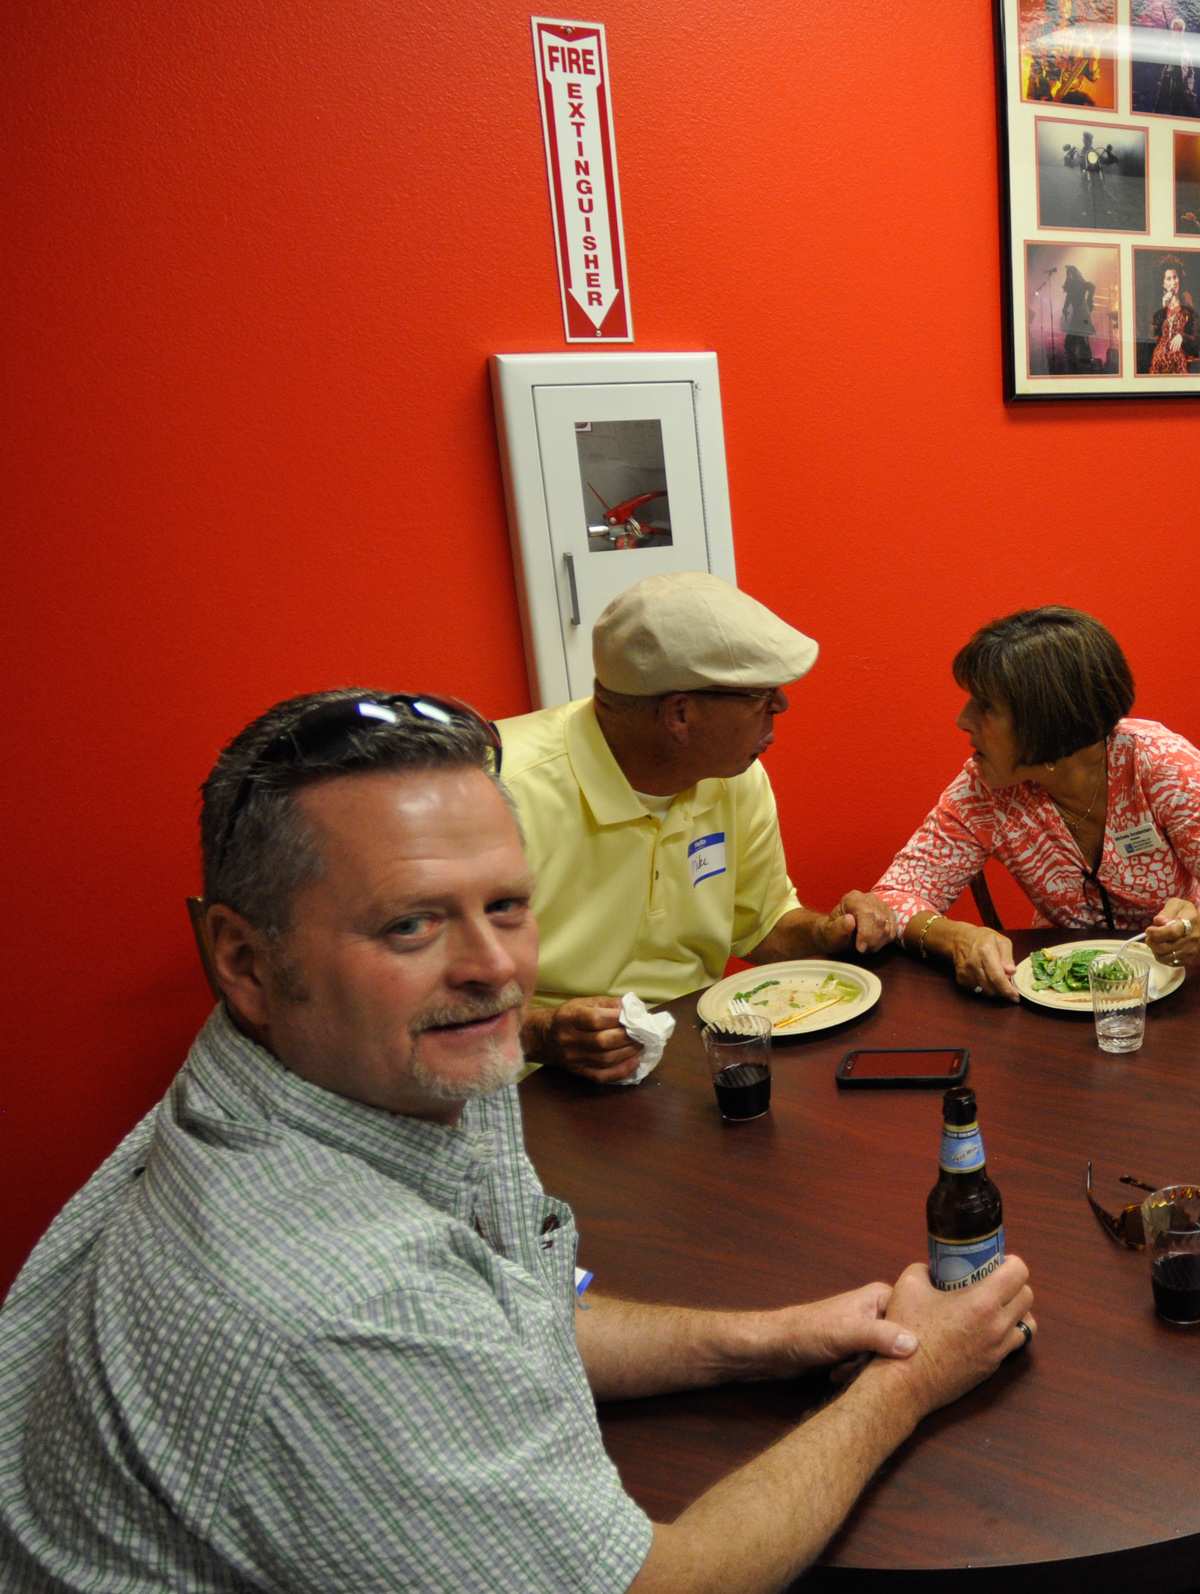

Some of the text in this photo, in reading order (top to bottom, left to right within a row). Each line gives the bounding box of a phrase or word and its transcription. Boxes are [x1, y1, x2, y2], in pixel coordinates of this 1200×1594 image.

[548, 45, 596, 75] FIRE
[567, 82, 603, 306] EXTINGUISHER
[971, 1256, 1000, 1283] MOON
